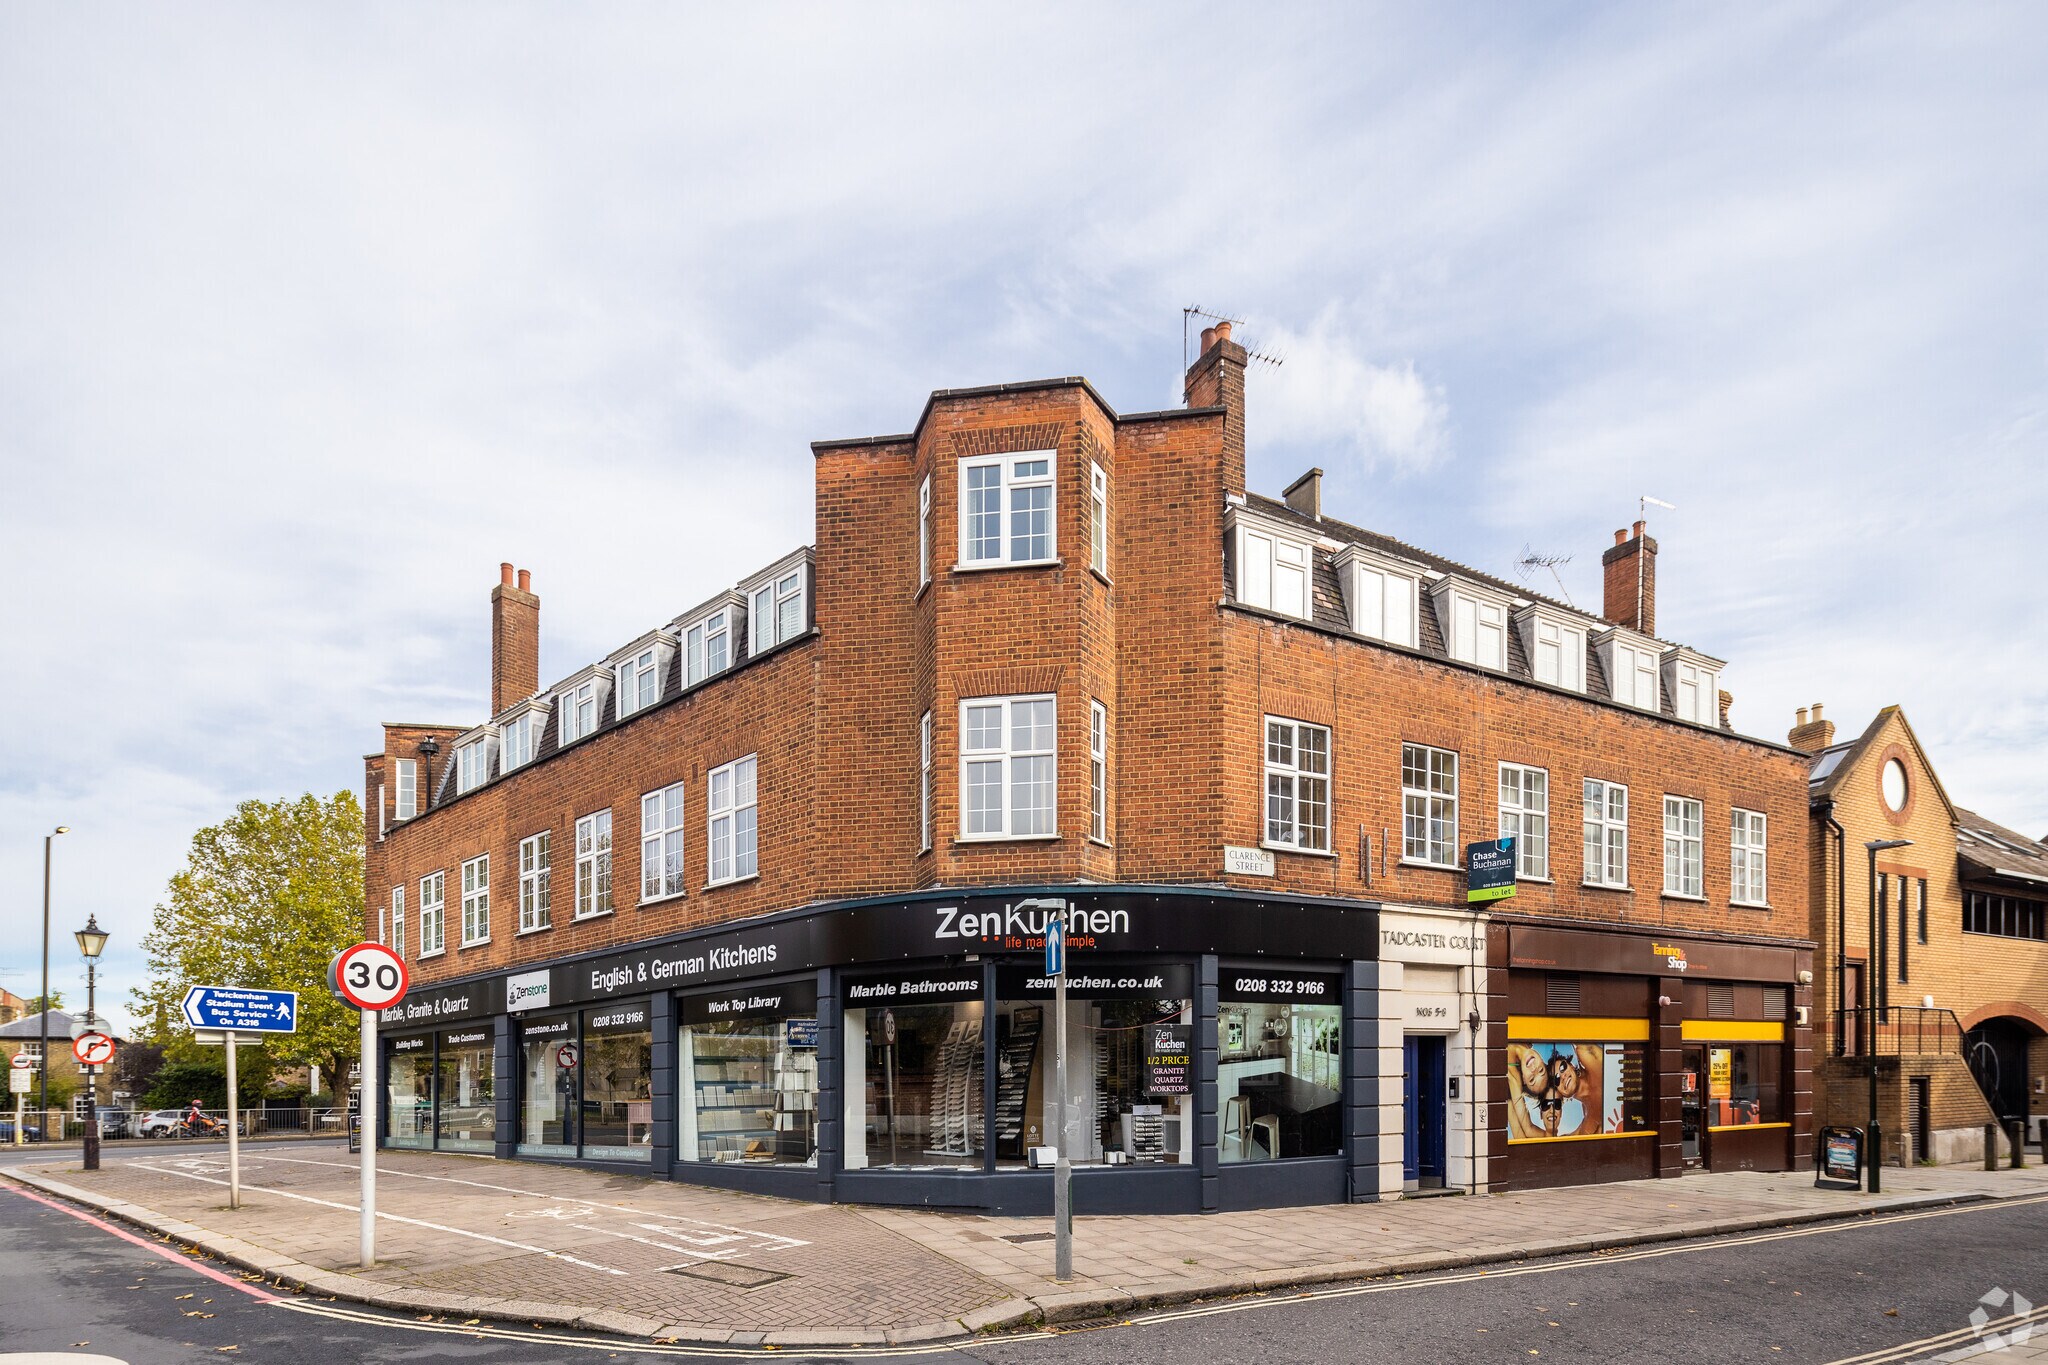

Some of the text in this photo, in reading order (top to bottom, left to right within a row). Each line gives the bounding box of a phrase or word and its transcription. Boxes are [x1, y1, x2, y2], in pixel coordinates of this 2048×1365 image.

[1229, 850, 1271, 863] CLARENCE
[1472, 851, 1498, 861] Chase
[1235, 861, 1264, 872] STREET
[1473, 858, 1512, 870] Buchanan
[1501, 888, 1511, 896] let
[1005, 936, 1022, 949] life
[1064, 934, 1096, 950] imple
[1380, 930, 1487, 951] TADCASTER COURT
[1651, 942, 1681, 961] Tanning
[591, 943, 777, 993] English & German Kitchens
[1667, 956, 1688, 973] Shop
[348, 961, 399, 991] 30
[1025, 975, 1163, 989] zenuchen.co.uk
[516, 982, 548, 1000] Zenstone
[849, 980, 979, 998] Marble Bathrooms
[1234, 978, 1326, 995] 0208 332 9166
[212, 990, 269, 1001] Twickenham
[206, 999, 274, 1010] Stadium Event
[380, 995, 469, 1023] Marble, Granite & Quartz
[708, 996, 781, 1014] Work Top Library
[211, 1008, 268, 1019] Bus Service
[592, 1011, 645, 1028] 0208 332 9166
[219, 1018, 260, 1027] On A316
[525, 1021, 569, 1036] zenstone.co.uk
[448, 1033, 486, 1044] Trade Customers
[1155, 1029, 1173, 1041] Zen
[395, 1039, 424, 1050] Building Works
[1147, 1055, 1190, 1065] 1/2 PRICE
[1153, 1067, 1185, 1075] GRANITE
[1154, 1076, 1184, 1085] QUARTZ
[1149, 1085, 1189, 1093] WORKTOPS
[592, 1148, 645, 1158] Design To Completion
